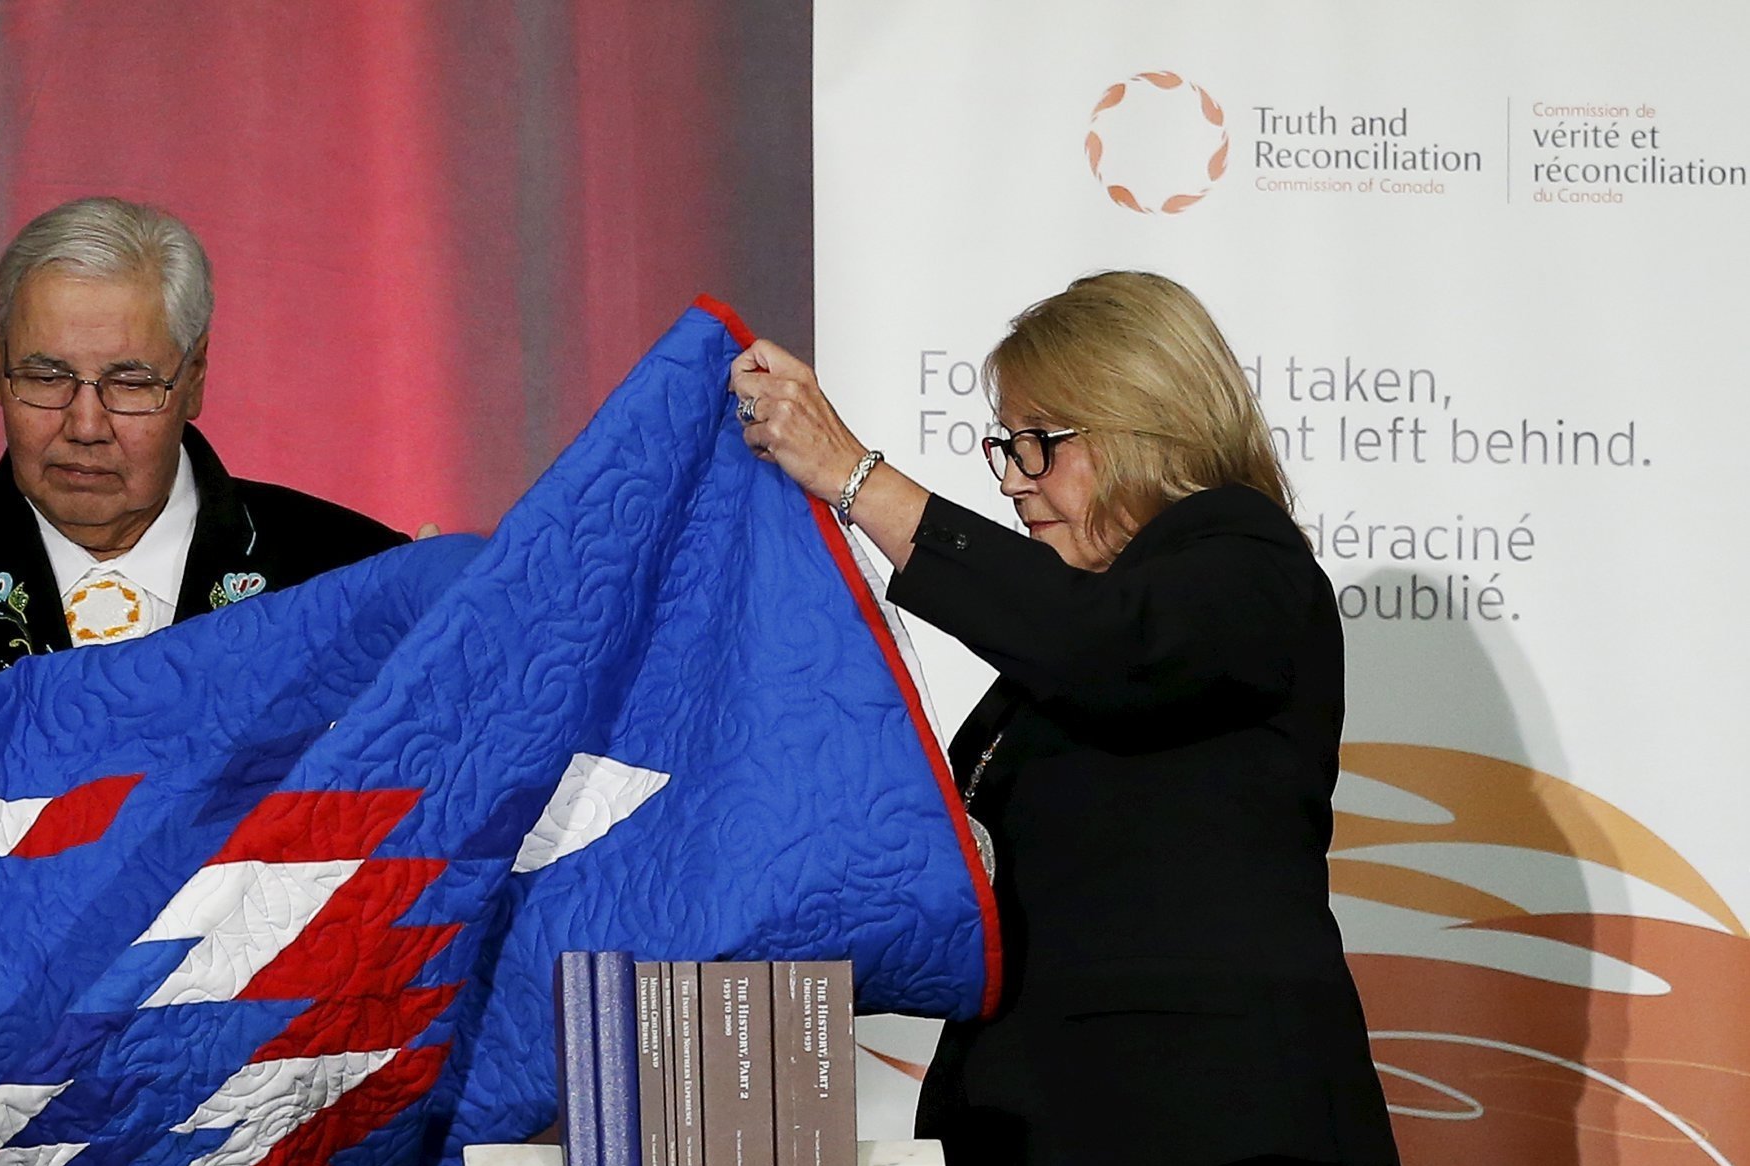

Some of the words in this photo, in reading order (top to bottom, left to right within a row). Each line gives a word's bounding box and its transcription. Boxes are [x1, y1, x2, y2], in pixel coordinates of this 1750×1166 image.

[1253, 107, 1336, 137] Truth
[1351, 107, 1407, 137] and
[1533, 102, 1628, 119] Commission
[1636, 103, 1655, 119] de
[1533, 122, 1620, 149] vérité
[1631, 127, 1659, 149] et
[1254, 142, 1482, 172] Reconciliation
[1533, 156, 1746, 186] réconciliation
[1256, 177, 1352, 193] Commission
[1357, 177, 1373, 193] of
[1380, 178, 1444, 194] Canada
[1533, 189, 1552, 204] du
[1558, 190, 1622, 204] Canada
[920, 350, 978, 396] Fo
[1285, 356, 1453, 410] taken,
[1341, 415, 1427, 463] left
[1452, 419, 1652, 467] behind.
[1338, 575, 1520, 622] oublié.
